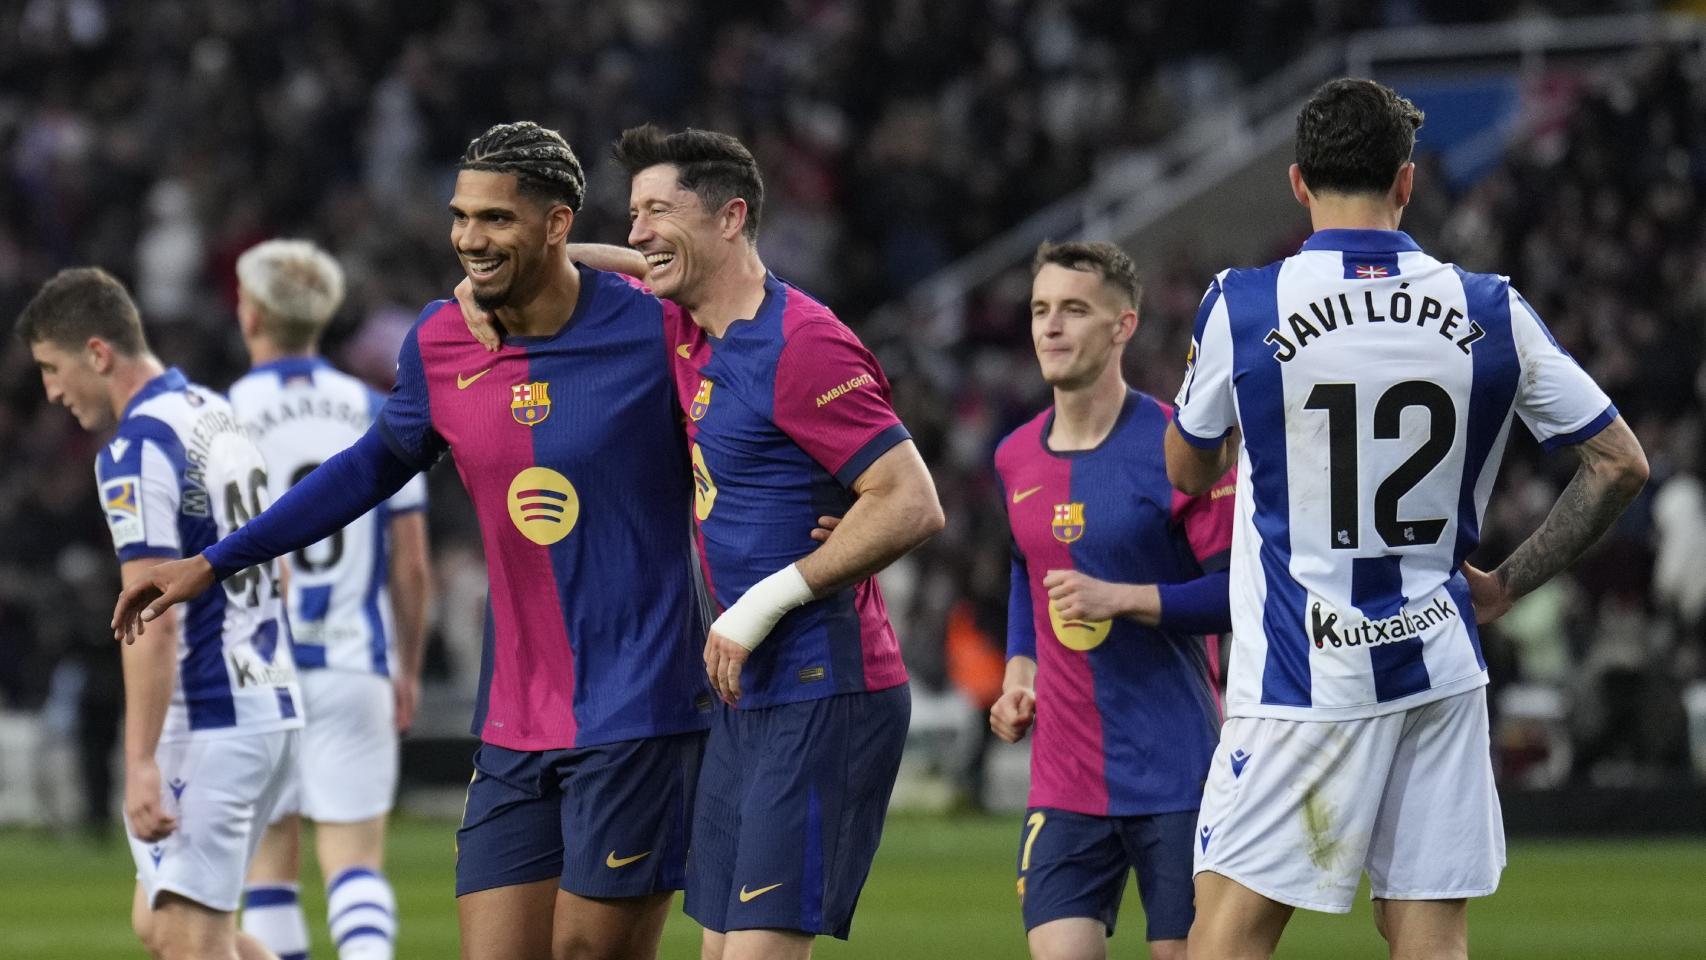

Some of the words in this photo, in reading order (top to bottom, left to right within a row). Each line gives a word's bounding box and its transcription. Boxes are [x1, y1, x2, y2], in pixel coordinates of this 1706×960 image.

[1264, 293, 1354, 362] JAVI
[1364, 282, 1485, 355] LÓPEZ
[1304, 380, 1456, 549] 12
[1312, 598, 1456, 649] Kutxabank
[1022, 811, 1046, 871] 7
